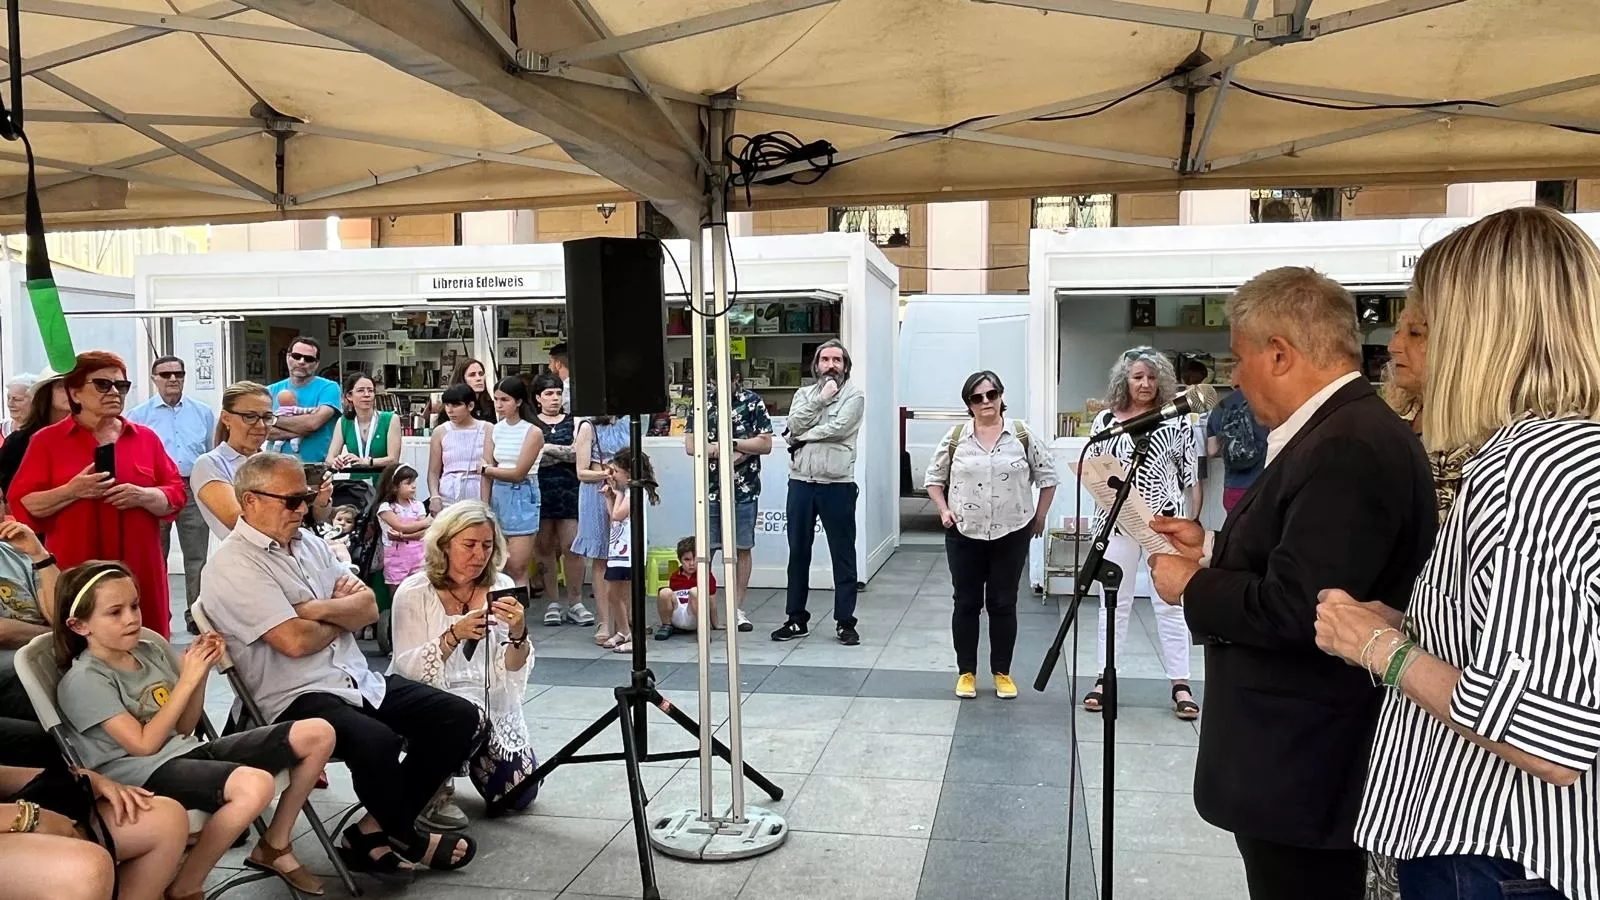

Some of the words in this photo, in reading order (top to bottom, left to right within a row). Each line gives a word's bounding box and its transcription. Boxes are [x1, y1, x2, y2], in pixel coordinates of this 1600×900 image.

[476, 275, 524, 288] Edelweis
[764, 511, 788, 521] GOB
[764, 522, 780, 532] DE
